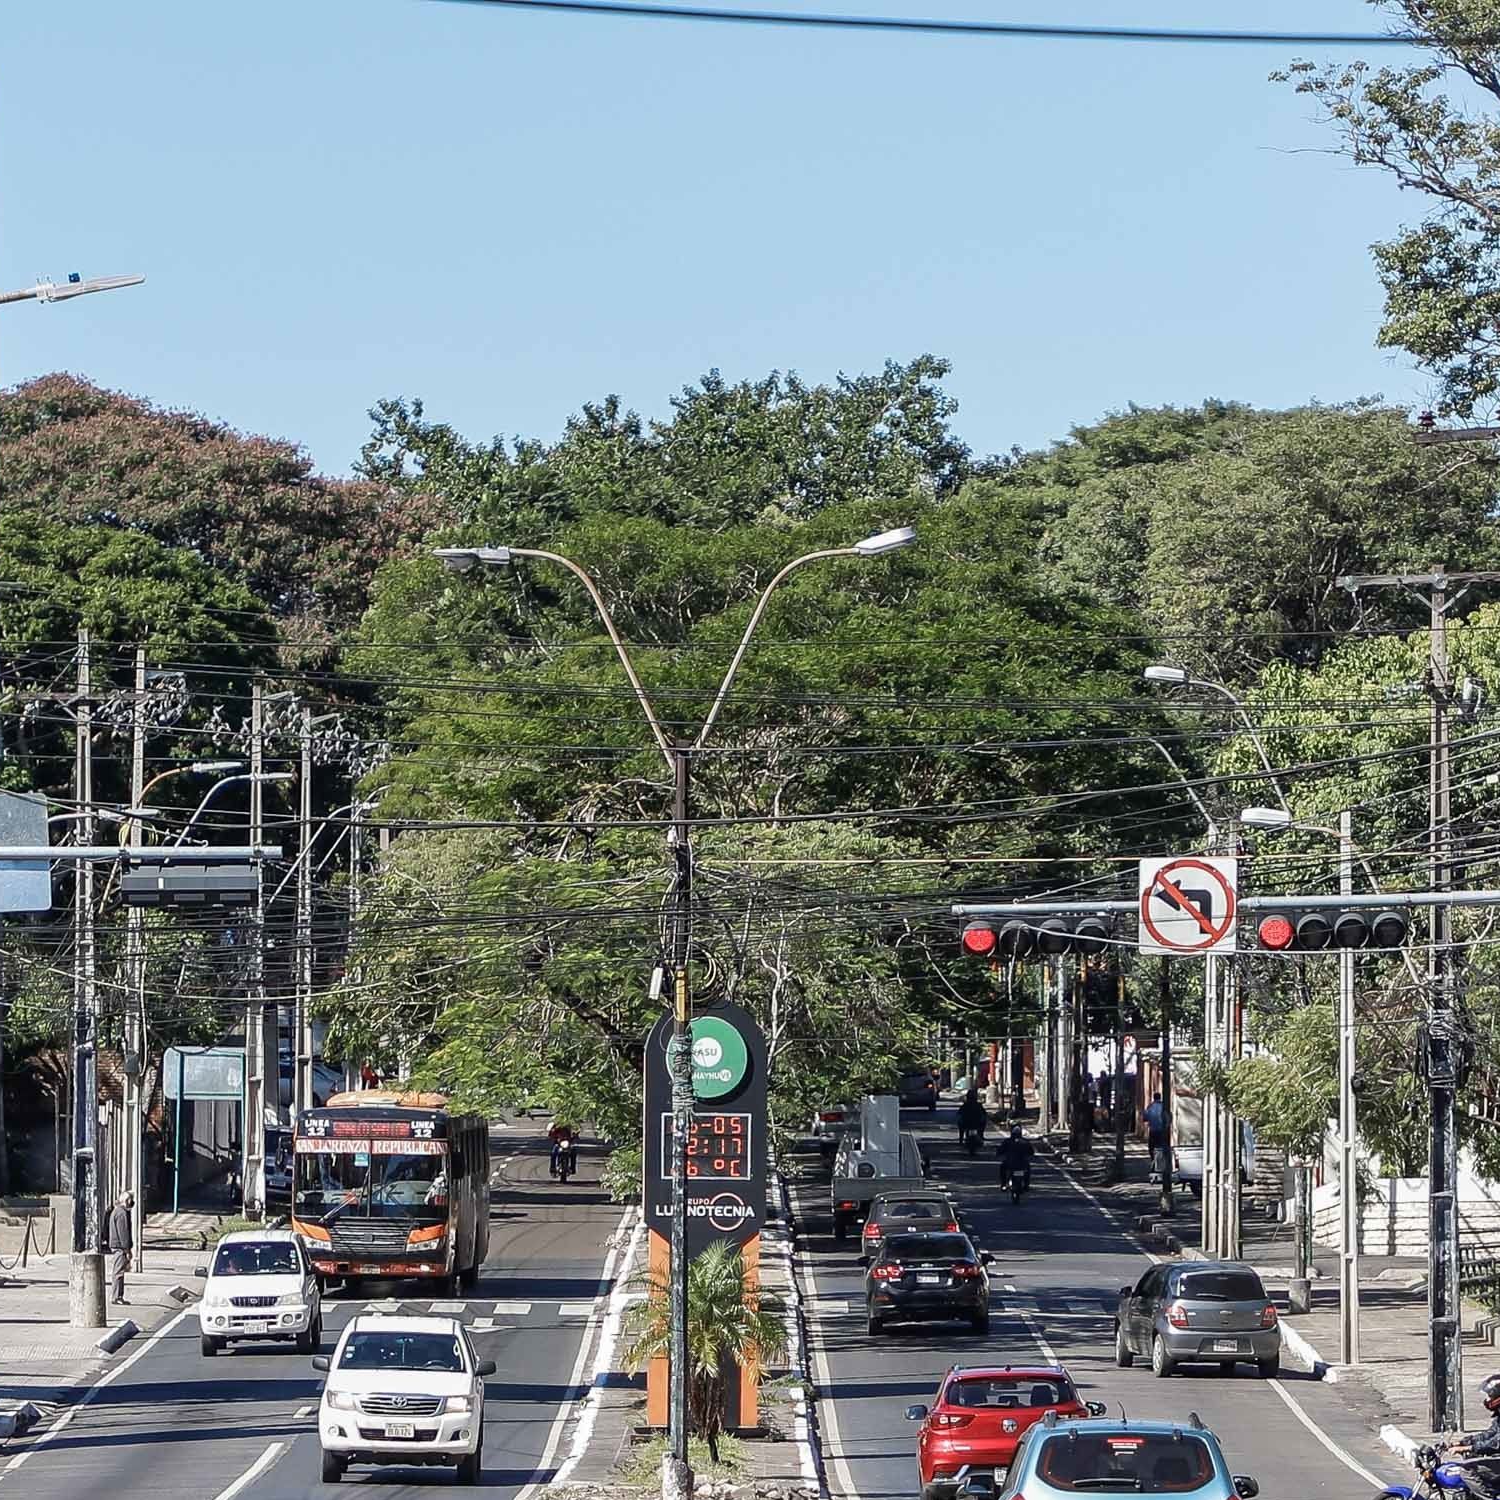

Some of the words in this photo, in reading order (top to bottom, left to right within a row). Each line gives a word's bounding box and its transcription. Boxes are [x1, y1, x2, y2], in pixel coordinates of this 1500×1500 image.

[305, 1119, 330, 1128] LINEA
[411, 1121, 435, 1130] LINEA
[307, 1128, 326, 1136] 12
[414, 1130, 432, 1138] 12
[318, 1140, 371, 1153] LORENZO
[655, 1204, 756, 1217] LUNOTECNIA
